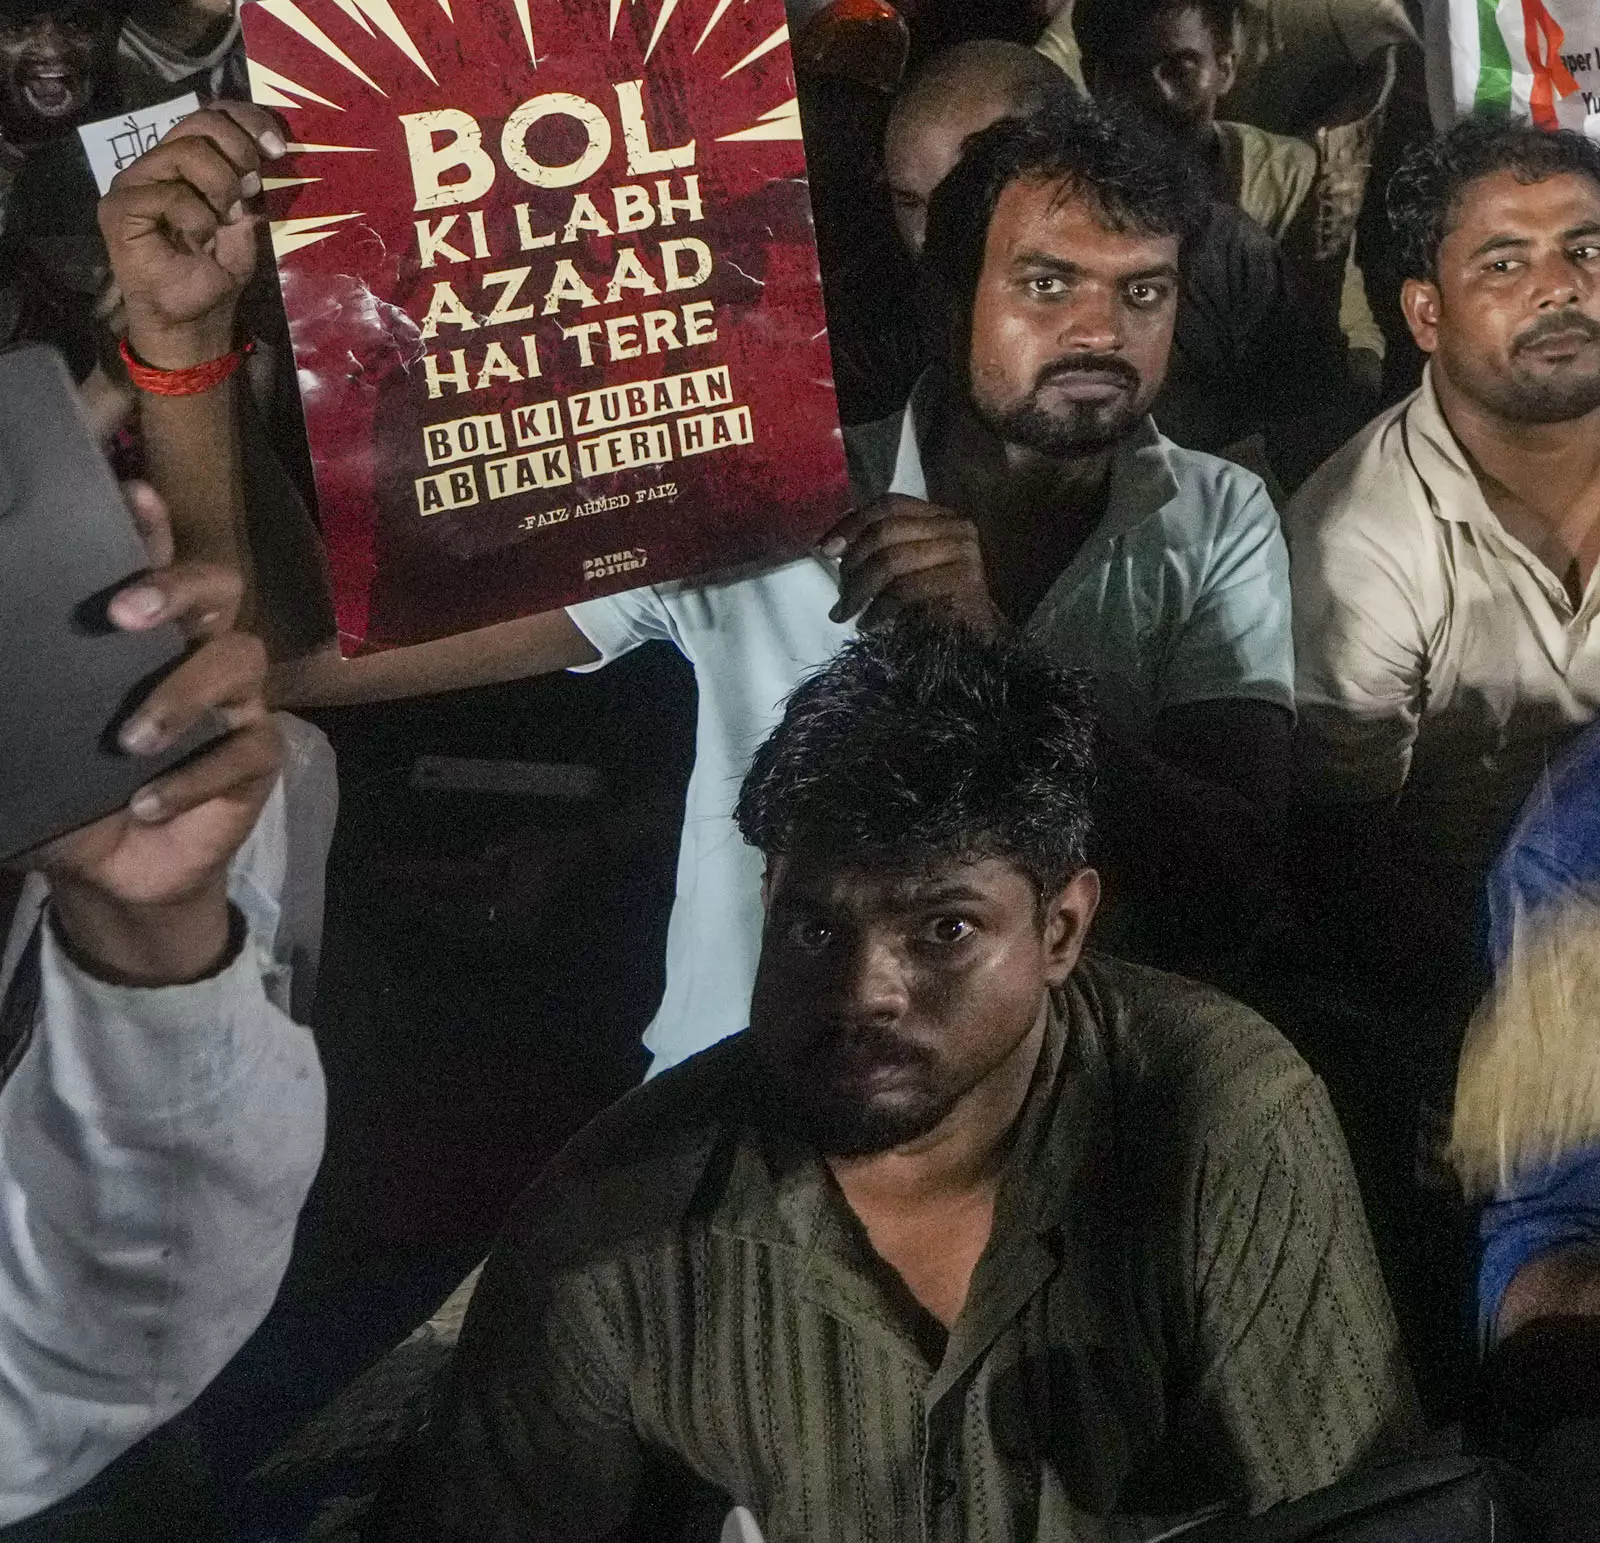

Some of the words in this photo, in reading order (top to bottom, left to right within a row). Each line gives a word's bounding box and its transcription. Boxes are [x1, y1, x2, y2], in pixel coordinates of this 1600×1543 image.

[399, 80, 696, 211] BOL
[414, 210, 492, 269] KI
[514, 174, 705, 251] LABH
[419, 237, 713, 340] AZAAD
[422, 334, 542, 399] HAI
[563, 300, 718, 368] TERE
[422, 471, 475, 509] AB
[489, 449, 569, 494] TAK
[582, 428, 667, 469] TERI
[680, 411, 751, 450] HAI
[427, 420, 503, 462] BOL
[517, 407, 559, 441] KI
[573, 369, 731, 428] ZUBAAN
[574, 494, 630, 518] AHMED
[635, 482, 678, 505] FAIZ
[584, 557, 648, 581] POSTERS
